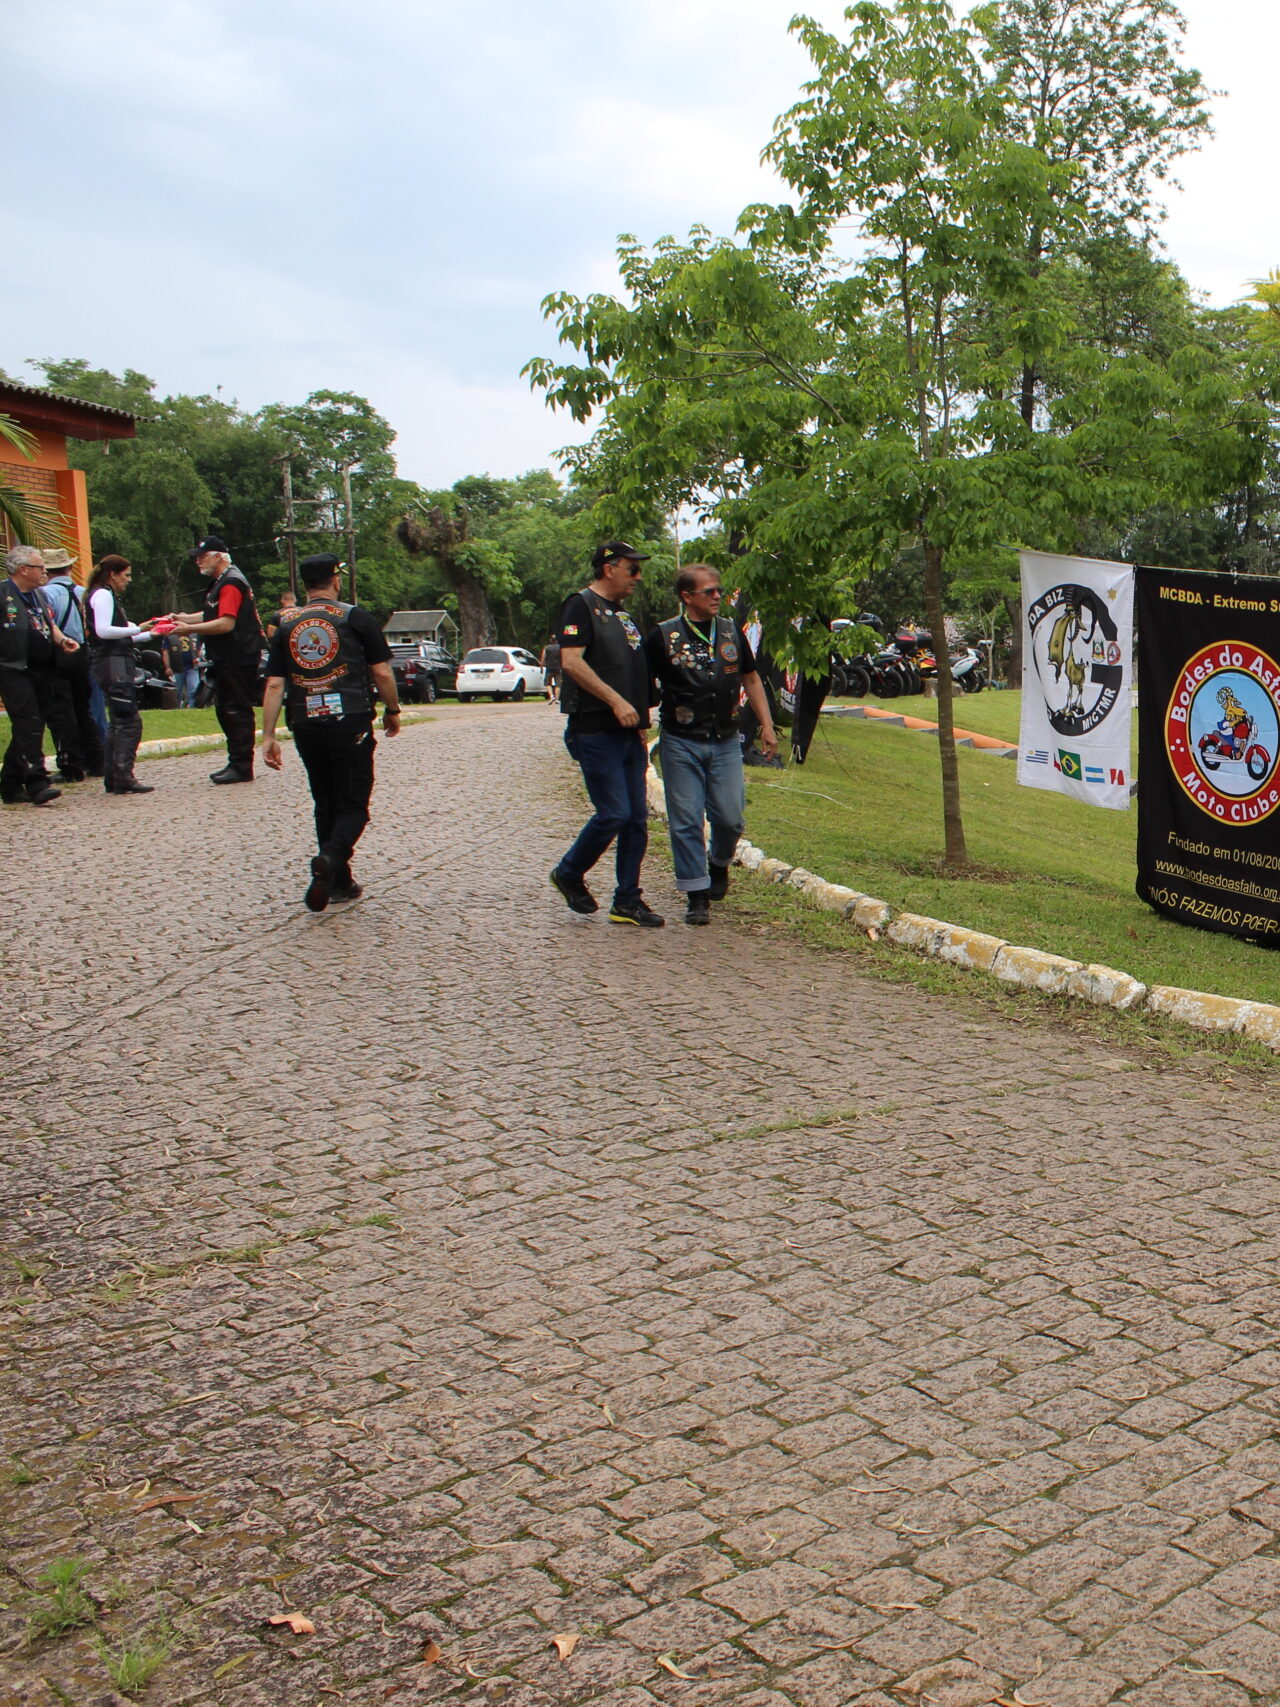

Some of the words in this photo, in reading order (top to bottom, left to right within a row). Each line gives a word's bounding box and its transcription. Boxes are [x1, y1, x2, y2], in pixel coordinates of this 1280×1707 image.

[1029, 605, 1045, 625] DA
[1045, 588, 1065, 608] BIZ
[1160, 586, 1203, 605] MCBDA
[1214, 594, 1266, 612] Extremo
[1171, 658, 1214, 723] Bodes
[1219, 645, 1243, 667] do
[1082, 688, 1116, 731] MICTMR
[1183, 771, 1225, 816] Moto
[1231, 789, 1279, 820] Clube
[1214, 847, 1230, 860] em
[1180, 896, 1241, 926] FAZEMOS
